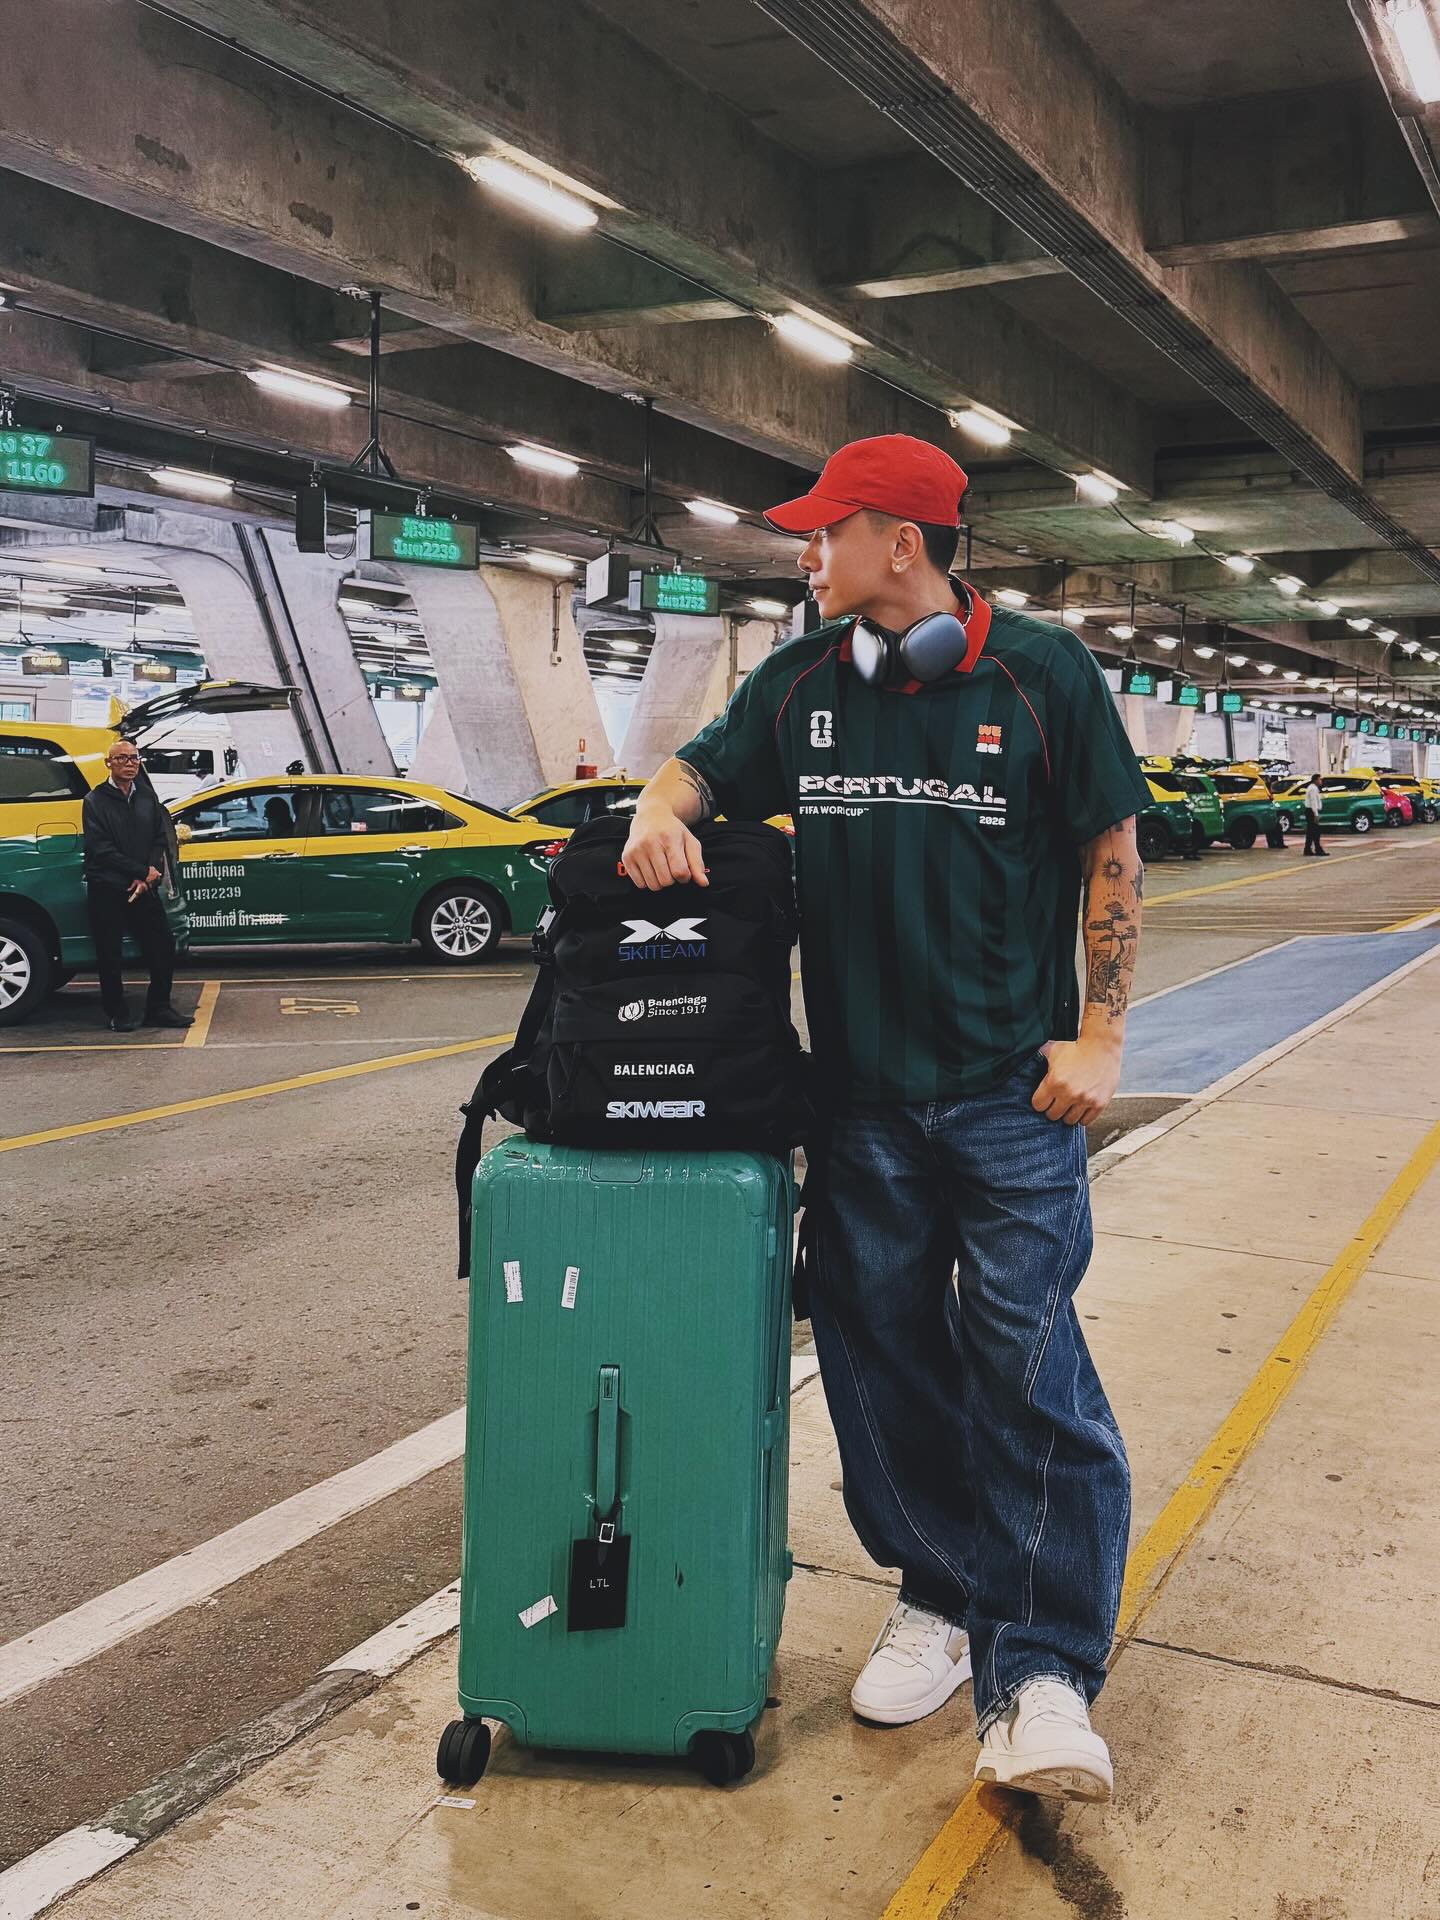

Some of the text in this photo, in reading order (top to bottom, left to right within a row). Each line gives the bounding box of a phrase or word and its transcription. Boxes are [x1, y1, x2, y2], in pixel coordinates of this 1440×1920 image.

[22, 434, 50, 457] 37
[8, 461, 64, 485] 1160
[978, 725, 1002, 736] WE
[799, 775, 1007, 805] PORTUGAL
[799, 806, 819, 815] FIFA
[979, 815, 1006, 826] 2026
[618, 943, 705, 961] SKITEAM
[647, 996, 707, 1008] Balenciaga
[647, 1004, 707, 1017] Since 1917
[613, 1063, 695, 1076] BALENCIAGA
[589, 1578, 610, 1589] LTL
